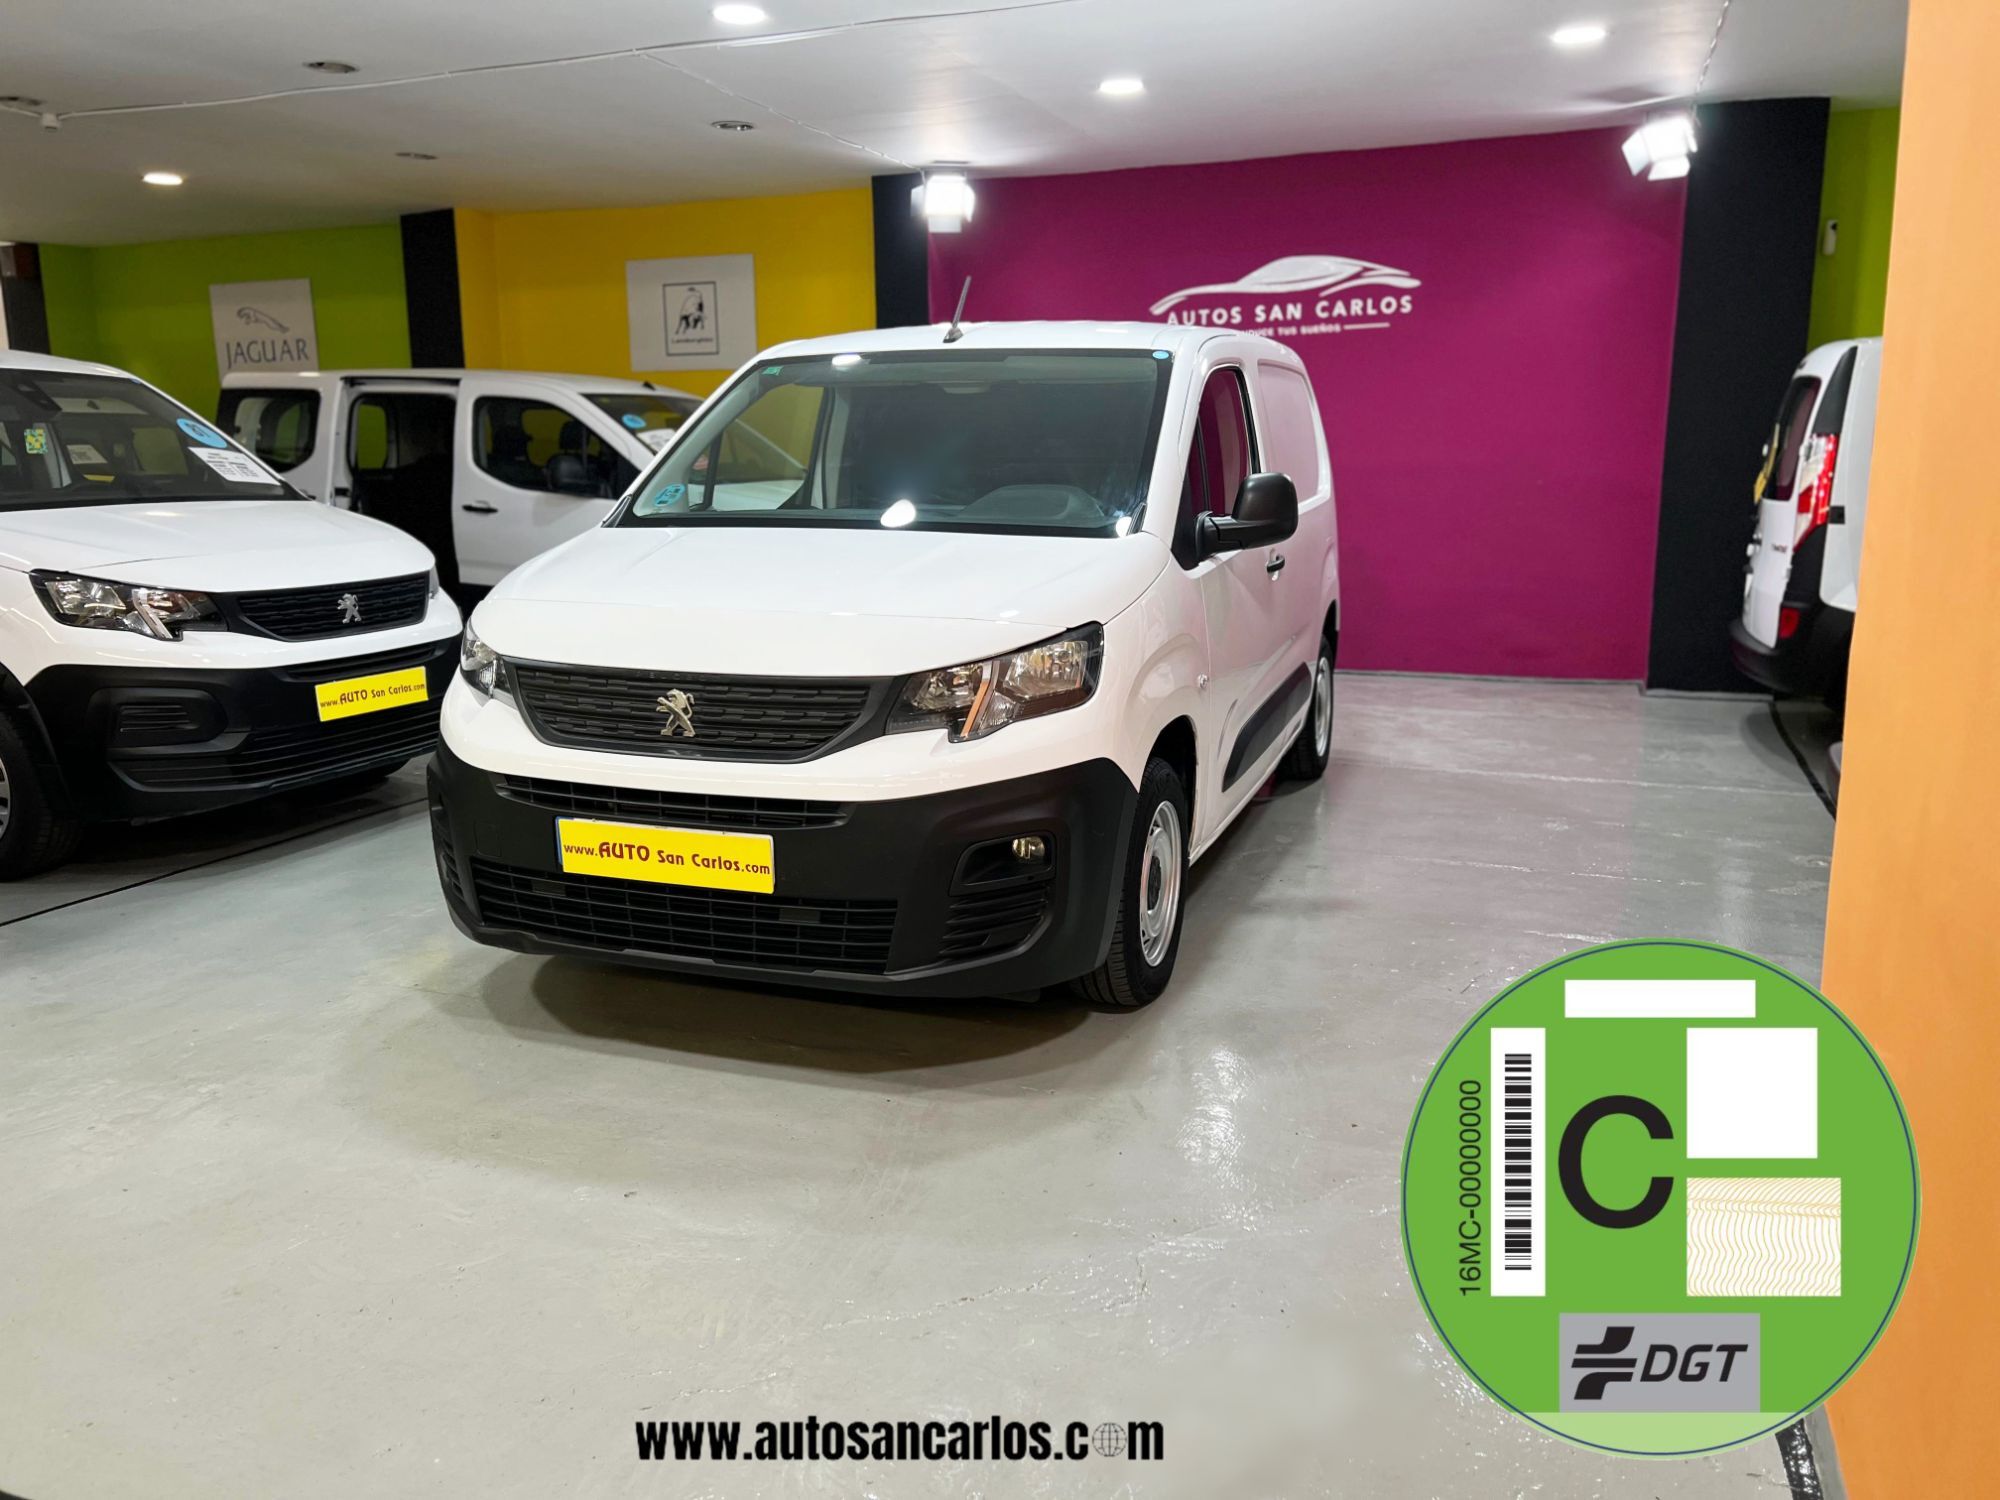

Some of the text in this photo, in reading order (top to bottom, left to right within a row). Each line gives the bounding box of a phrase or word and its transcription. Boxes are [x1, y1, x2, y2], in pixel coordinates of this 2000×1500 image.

[1167, 295, 1412, 326] AUTOS SAN CARLOS
[226, 337, 310, 369] JAGUAR
[320, 683, 425, 708] www.AUTO San Carlos.com
[563, 841, 771, 875] www.AUTO San Carlos.com
